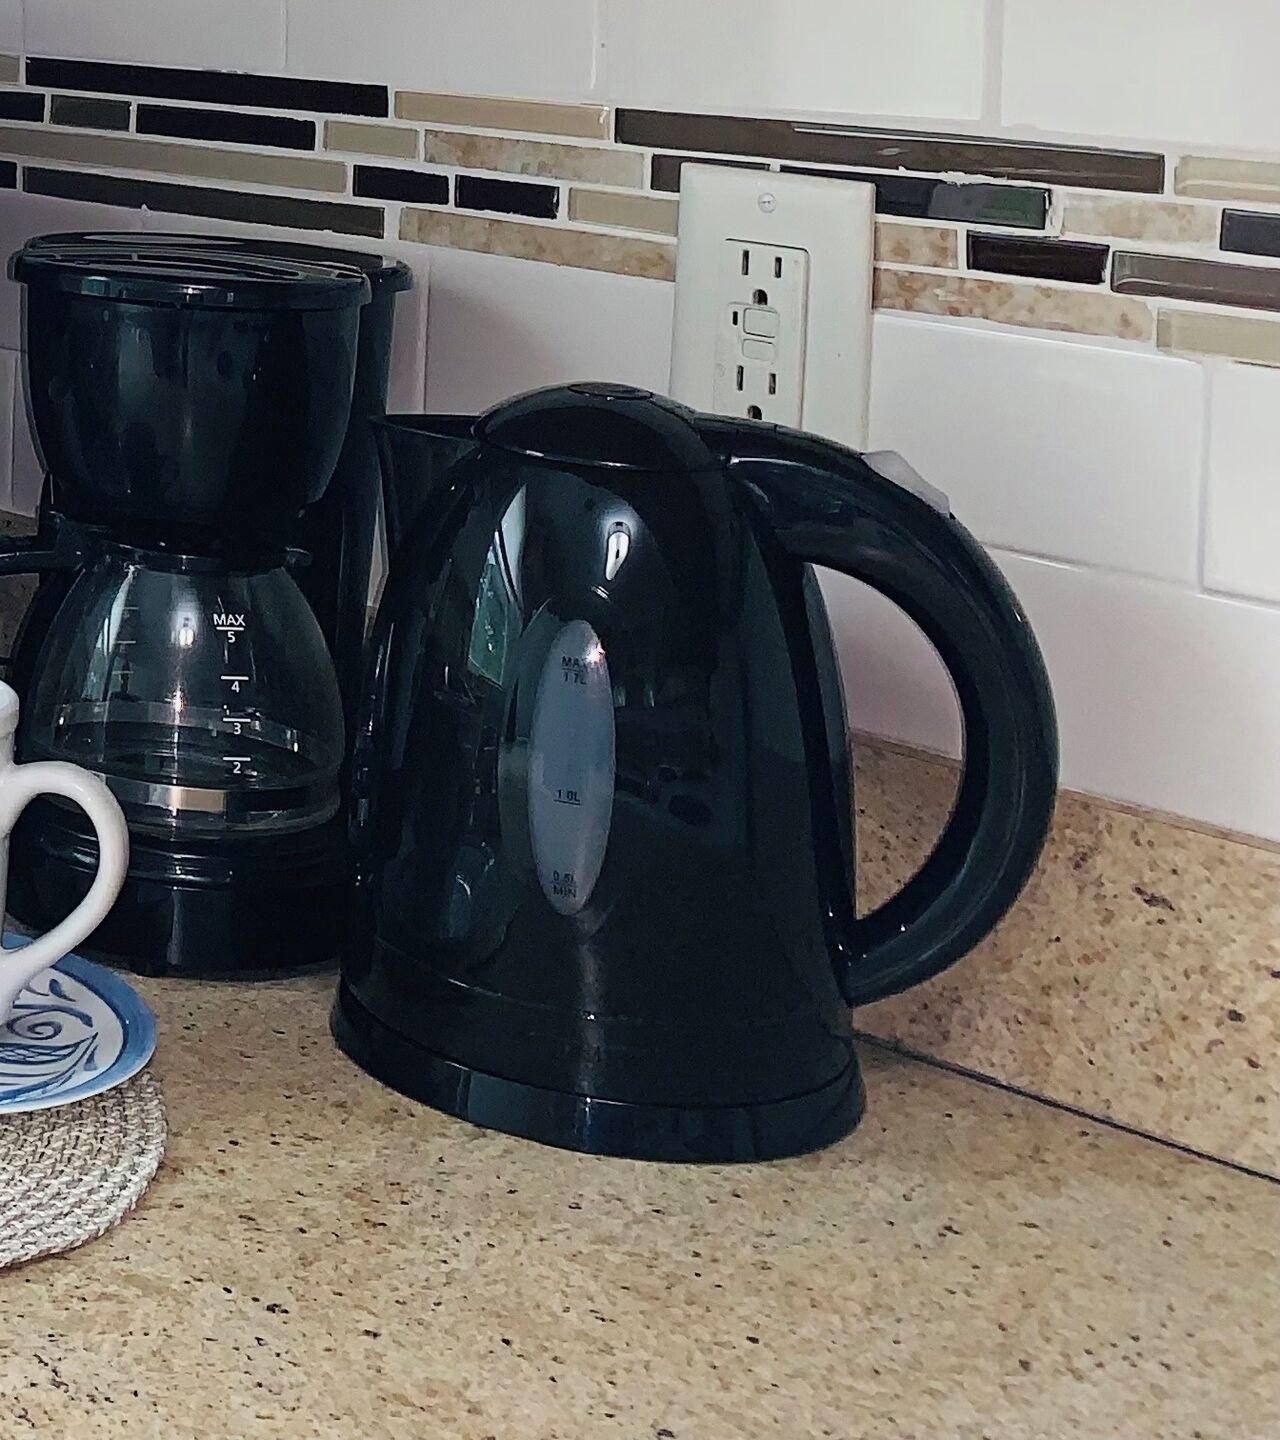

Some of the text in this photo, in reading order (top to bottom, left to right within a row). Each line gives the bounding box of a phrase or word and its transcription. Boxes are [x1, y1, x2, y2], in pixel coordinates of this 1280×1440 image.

[212, 612, 247, 627] MAX
[226, 630, 237, 644] 5
[230, 680, 241, 694] 4
[232, 722, 243, 736] 3
[232, 761, 243, 775] 2
